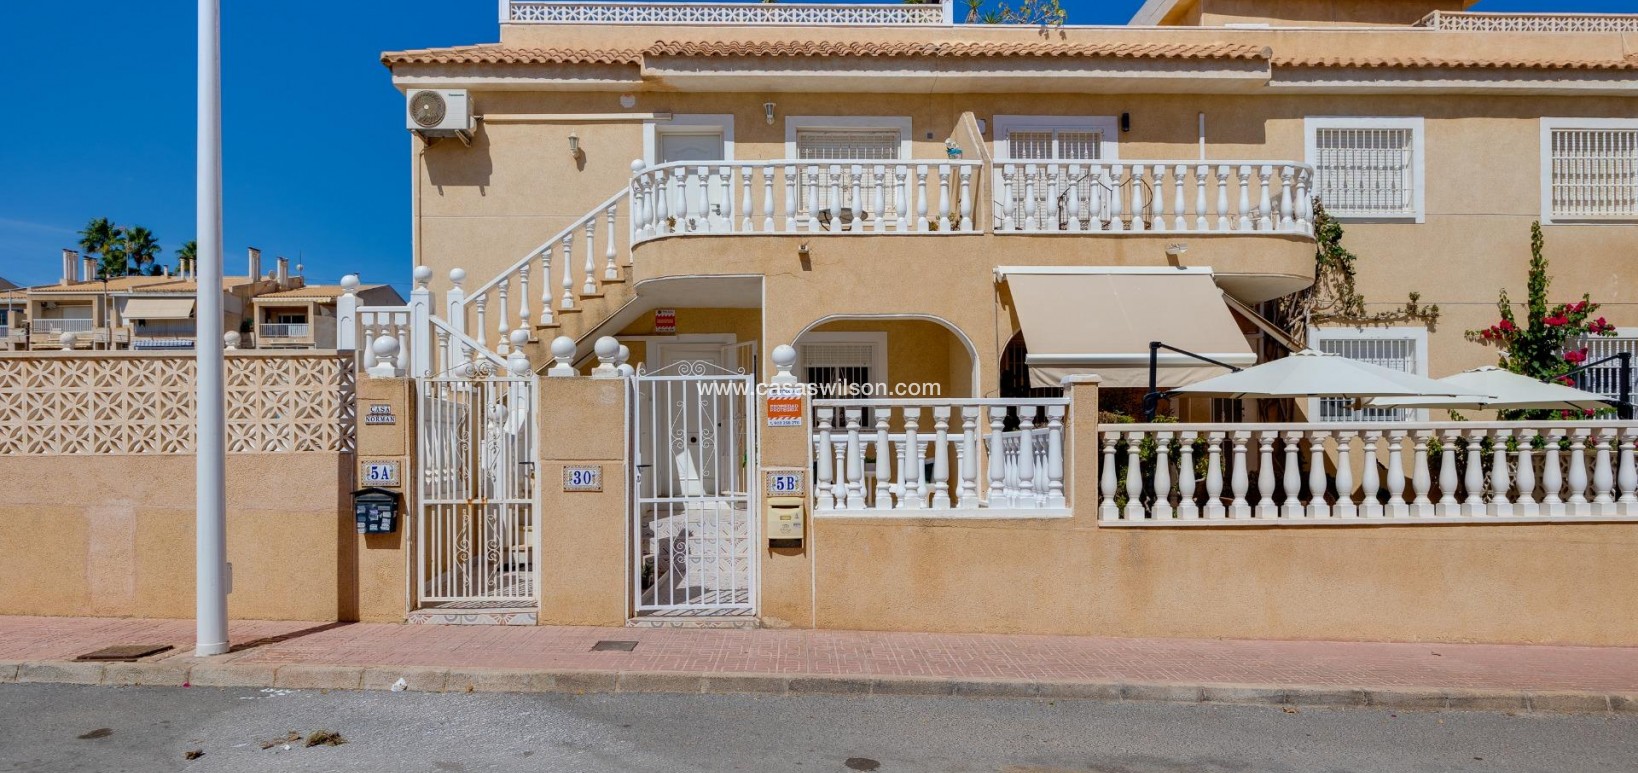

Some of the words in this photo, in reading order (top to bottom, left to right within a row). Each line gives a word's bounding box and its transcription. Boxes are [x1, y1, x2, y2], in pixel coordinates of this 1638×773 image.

[371, 466, 389, 480] 5A
[573, 470, 592, 485] 30
[776, 476, 795, 491] 5B
